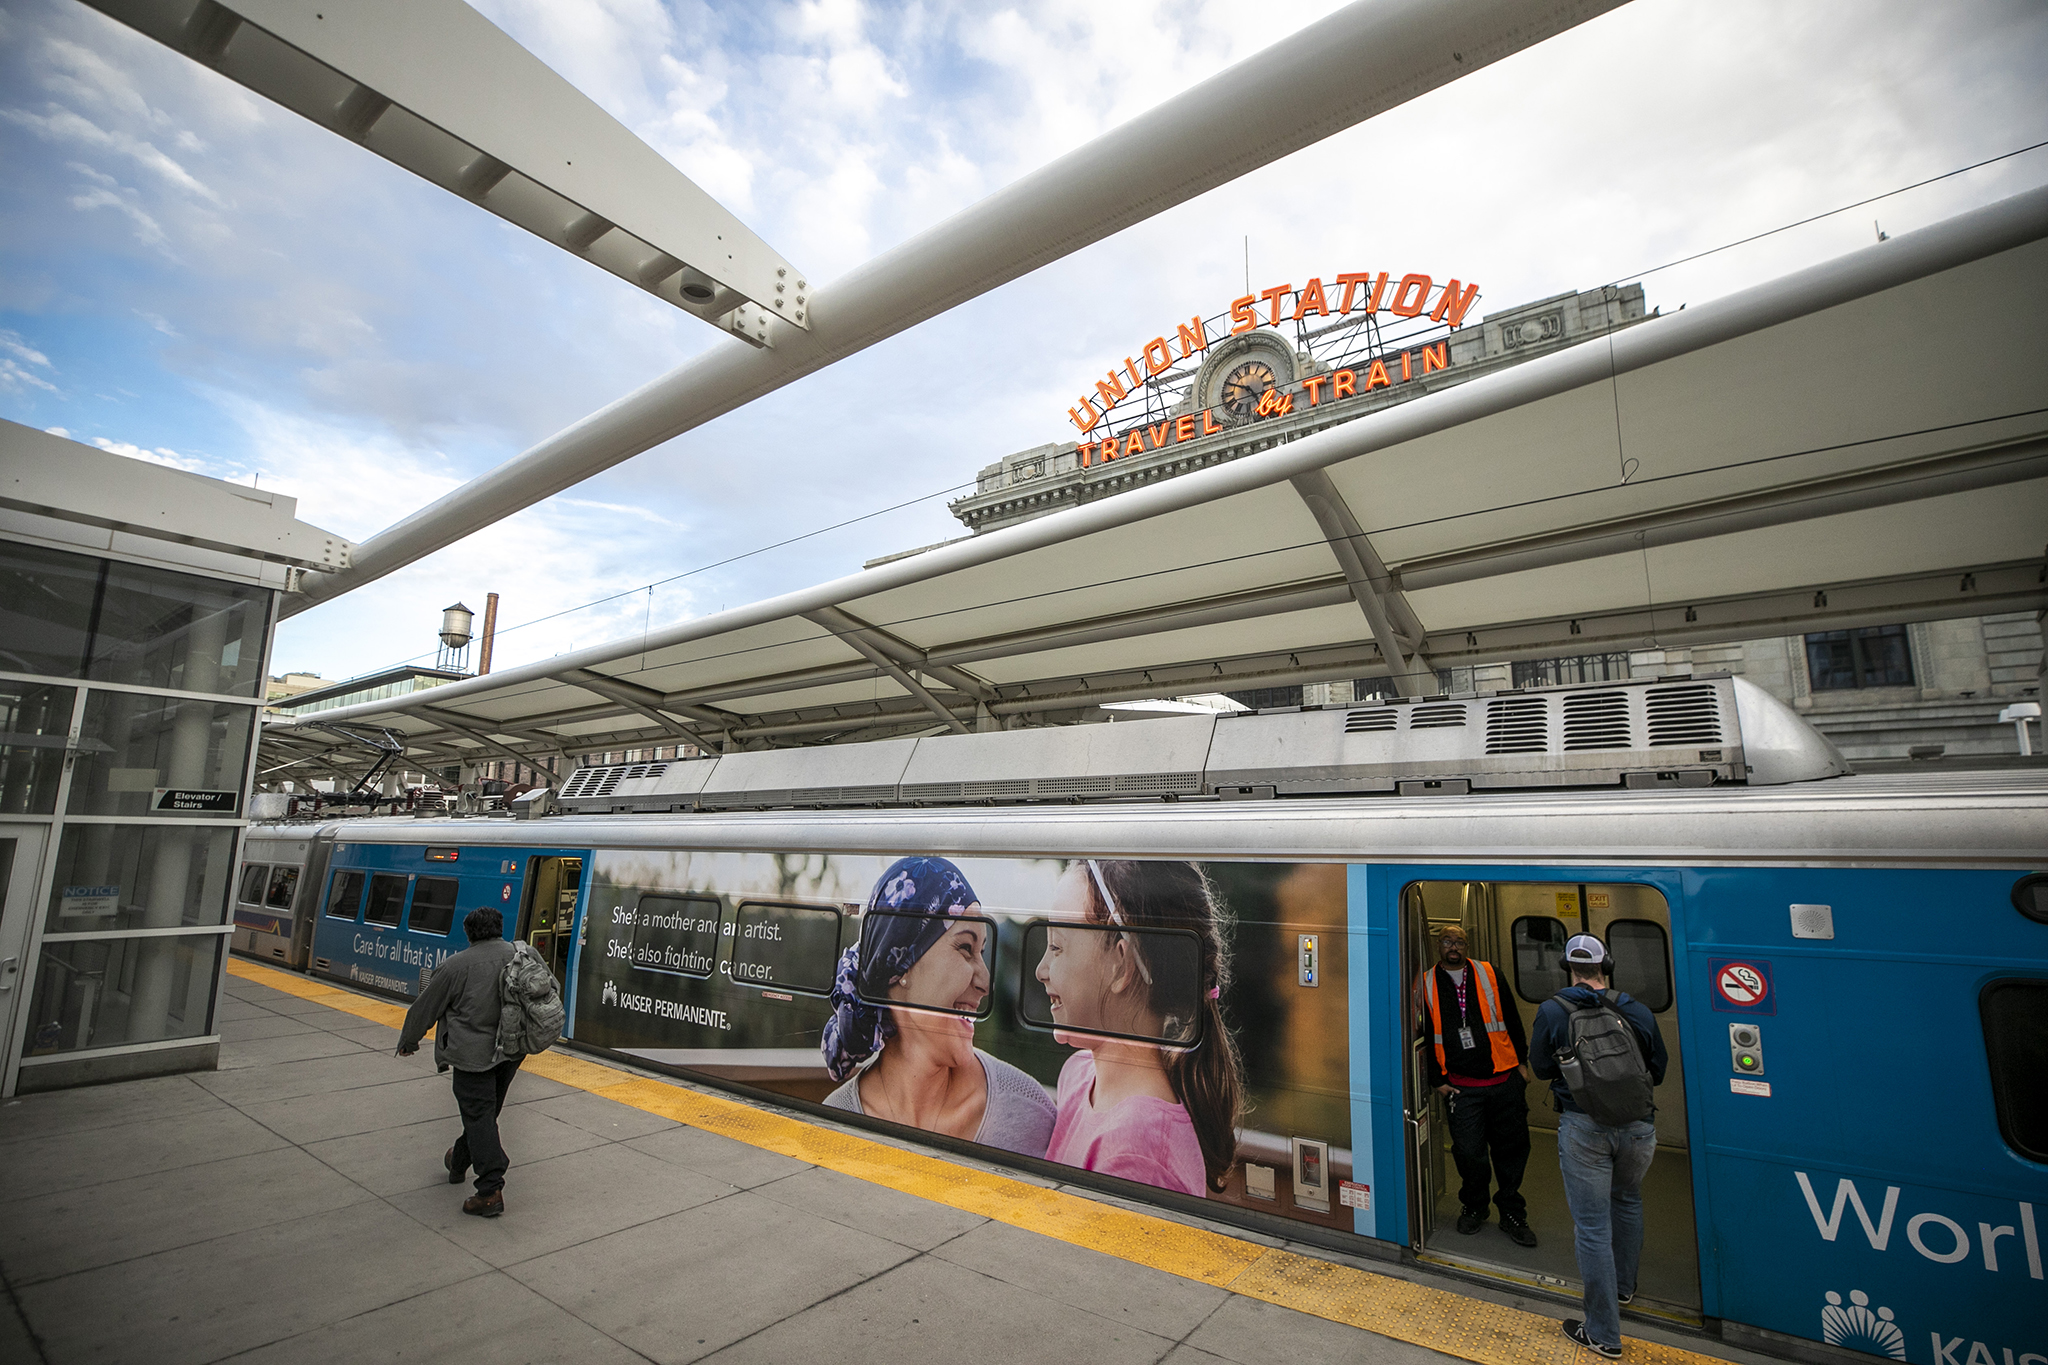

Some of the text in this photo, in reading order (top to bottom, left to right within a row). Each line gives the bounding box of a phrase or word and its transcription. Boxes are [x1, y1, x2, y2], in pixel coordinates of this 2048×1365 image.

[1068, 272, 1479, 433] UNION STATION
[1077, 341, 1448, 468] TRAVEL by TRAIN
[173, 800, 203, 809] Stairs
[174, 792, 215, 801] Elevator
[65, 886, 119, 896] NOTICE
[611, 905, 640, 925] She's
[642, 913, 649, 926] a
[652, 910, 695, 931] mother
[723, 921, 741, 936] an
[744, 920, 782, 941] artist.
[353, 932, 374, 956] Care
[375, 936, 389, 958] for
[390, 939, 402, 962] all
[403, 941, 422, 967] that
[424, 946, 434, 969] is
[606, 939, 635, 960] She's
[637, 943, 662, 964] also
[359, 971, 375, 986] KAISER
[620, 992, 652, 1014] KAISER
[1794, 1171, 2044, 1280] Worl
